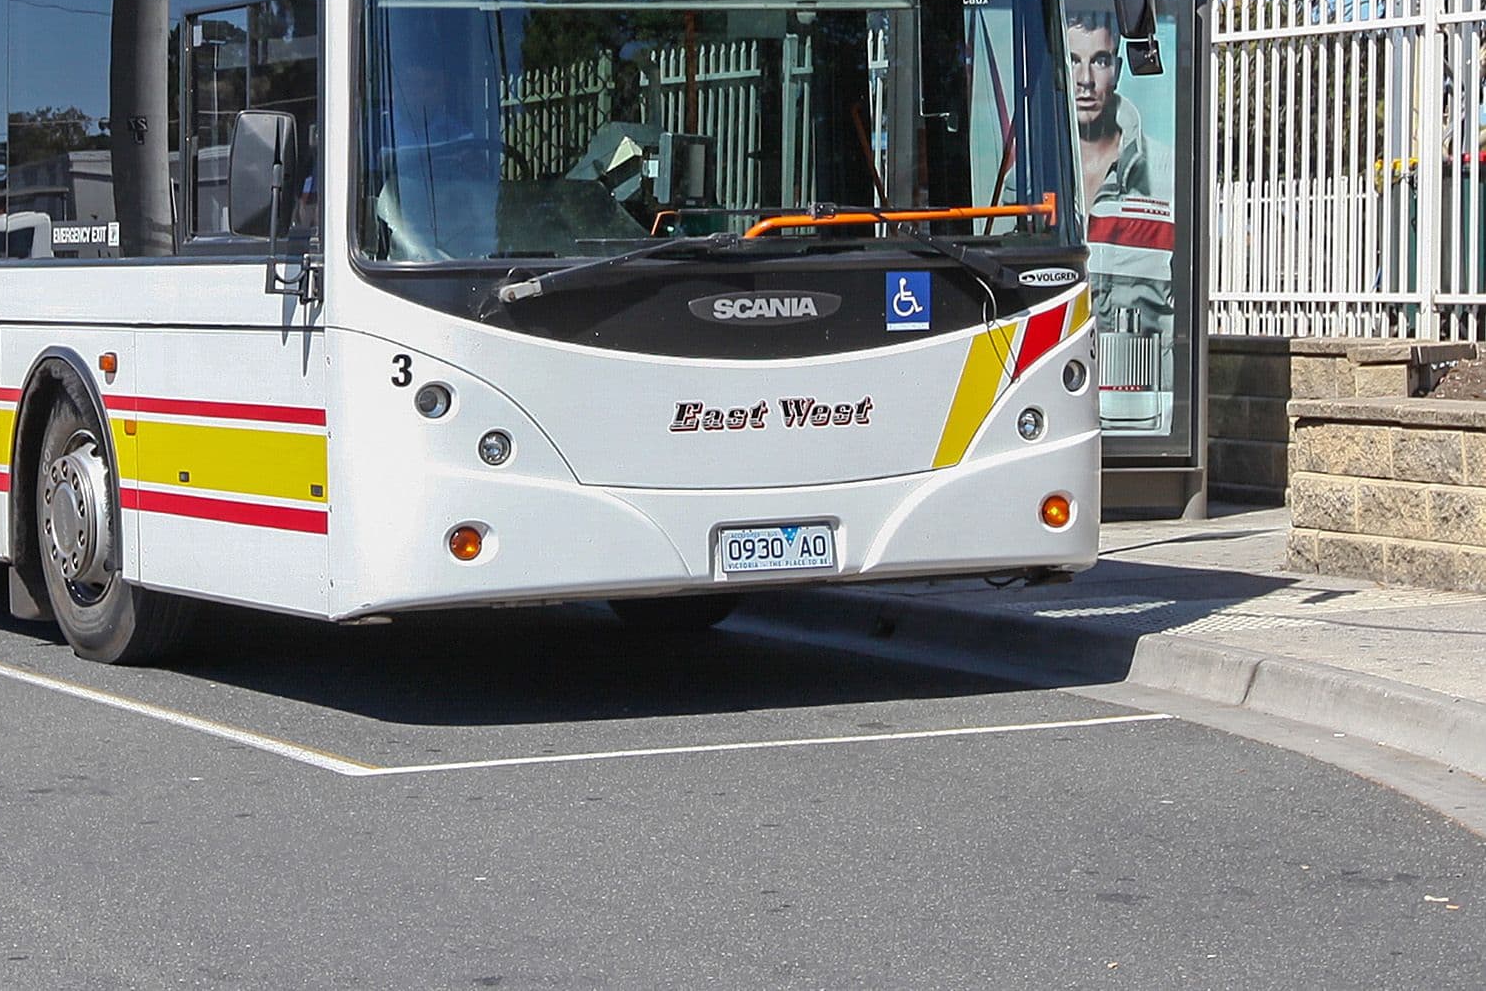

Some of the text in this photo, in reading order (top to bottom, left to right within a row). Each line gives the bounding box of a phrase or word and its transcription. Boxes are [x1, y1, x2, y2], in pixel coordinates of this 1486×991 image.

[91, 225, 107, 243] EXIT
[1036, 271, 1077, 282] VOLGREN
[713, 296, 819, 319] SCANIA
[391, 353, 412, 387] 3
[670, 396, 873, 432] East West
[728, 537, 784, 561] 0930
